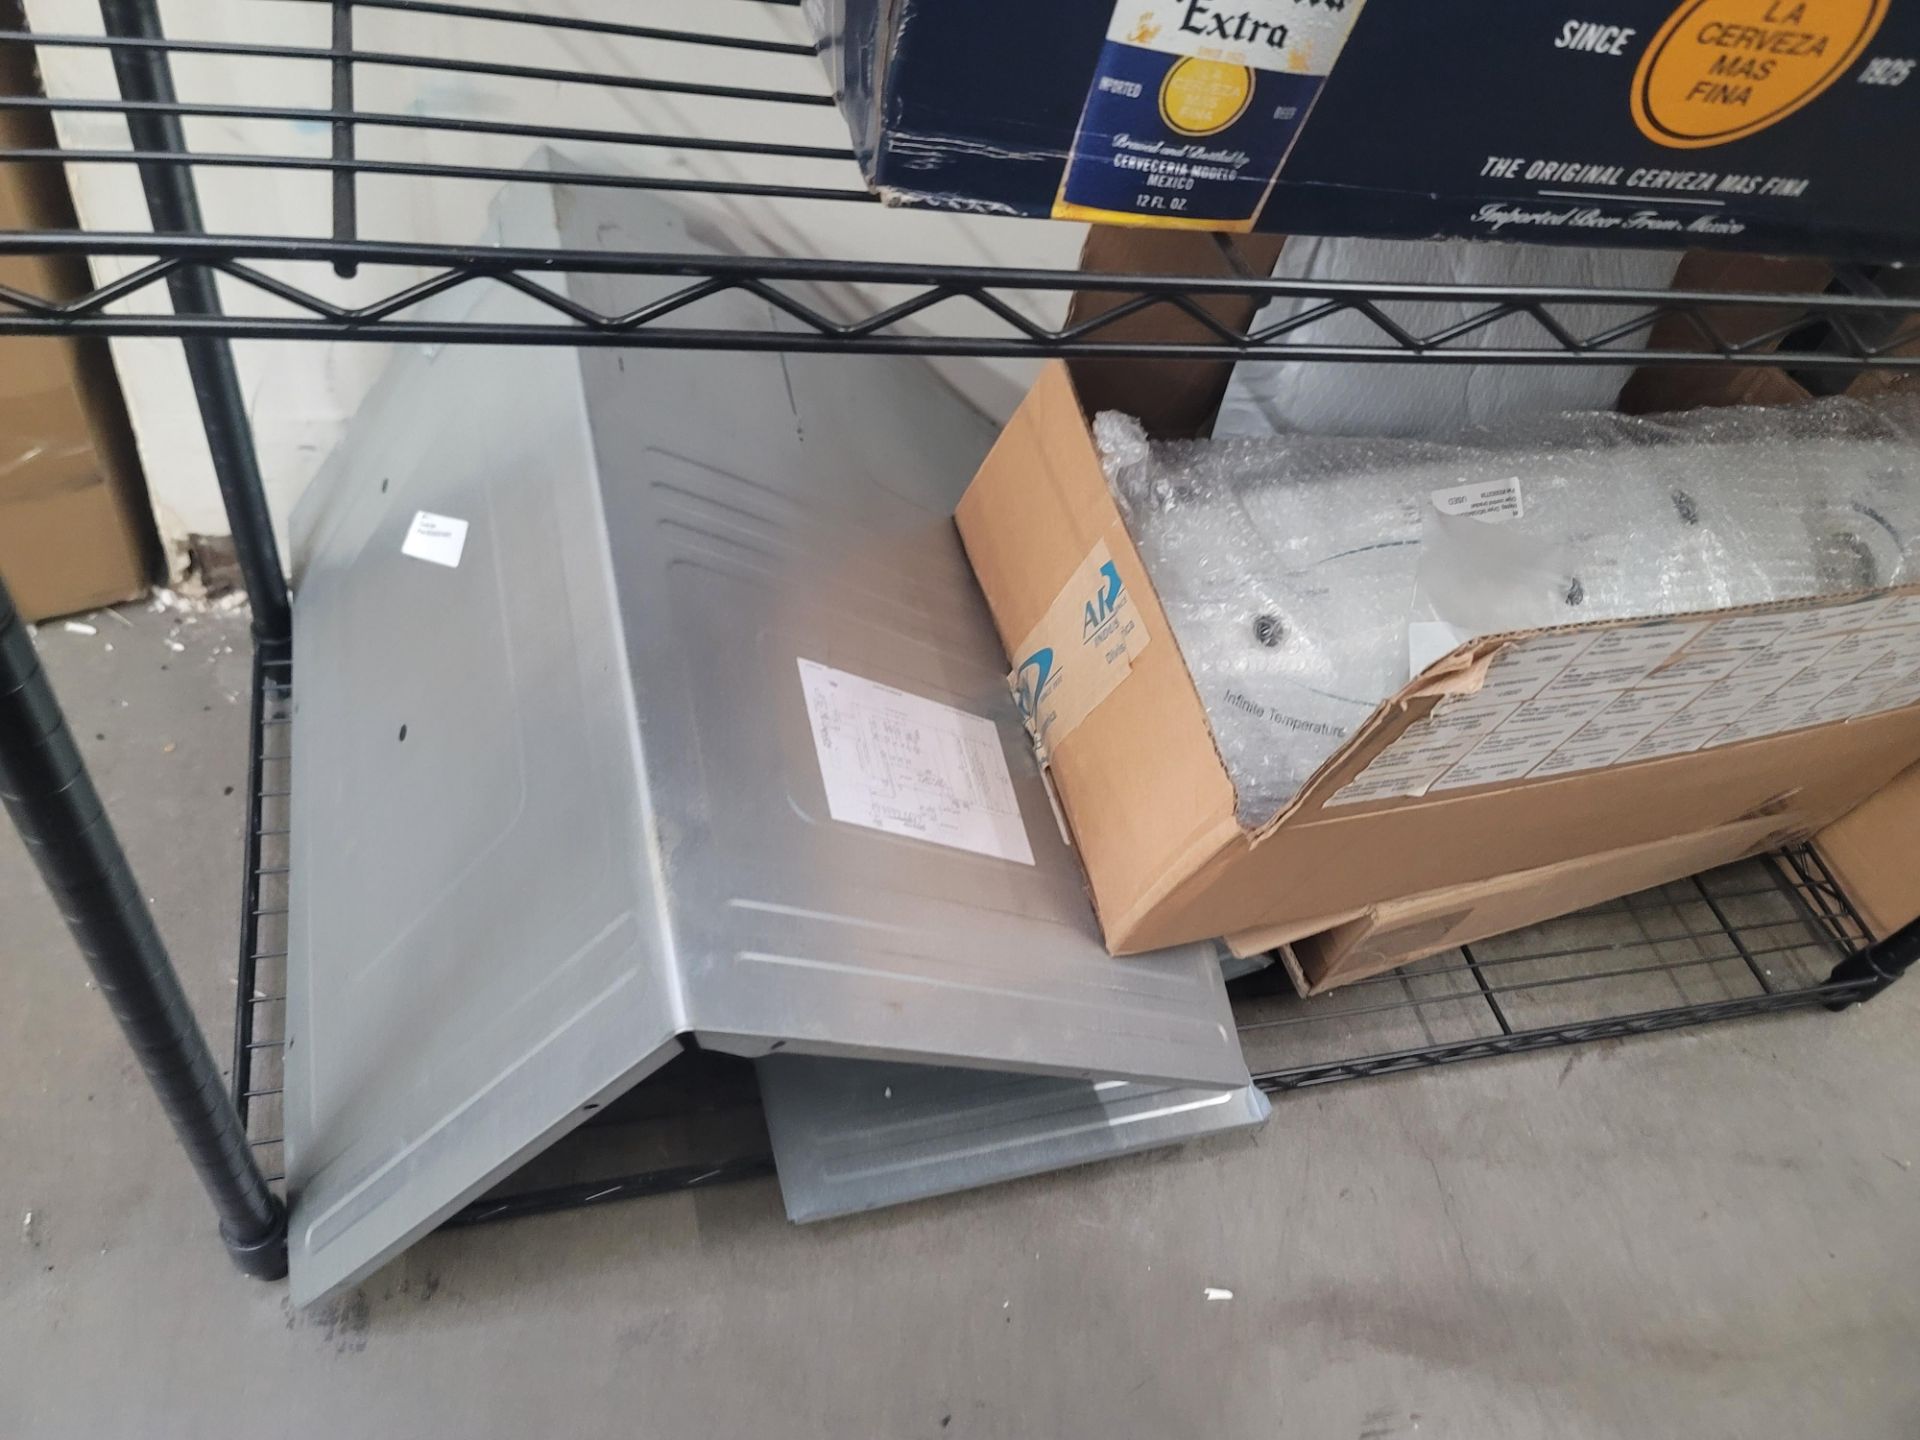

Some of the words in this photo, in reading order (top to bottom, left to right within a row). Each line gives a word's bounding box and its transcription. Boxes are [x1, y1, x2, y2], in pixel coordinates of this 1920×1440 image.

[1178, 0, 1289, 49] Extra
[1763, 0, 1807, 25] LA
[1555, 19, 1637, 56] SINCE
[1697, 22, 1829, 57] CERVEZA
[1708, 54, 1777, 81] MAS
[1686, 81, 1753, 106] FINA
[1113, 153, 1188, 176] CERVECERIA
[1190, 164, 1238, 181] MODELO
[1480, 156, 1526, 179] THE
[1524, 160, 1625, 186] ORIGINAL
[1626, 167, 1718, 191] CERVEZA
[1715, 174, 1763, 194] MAS
[1758, 177, 1809, 197] FINA
[1146, 173, 1195, 191] MEXICO
[1136, 194, 1151, 208] 12
[1223, 689, 1265, 718] Infinite
[1269, 706, 1346, 738] Temperature
